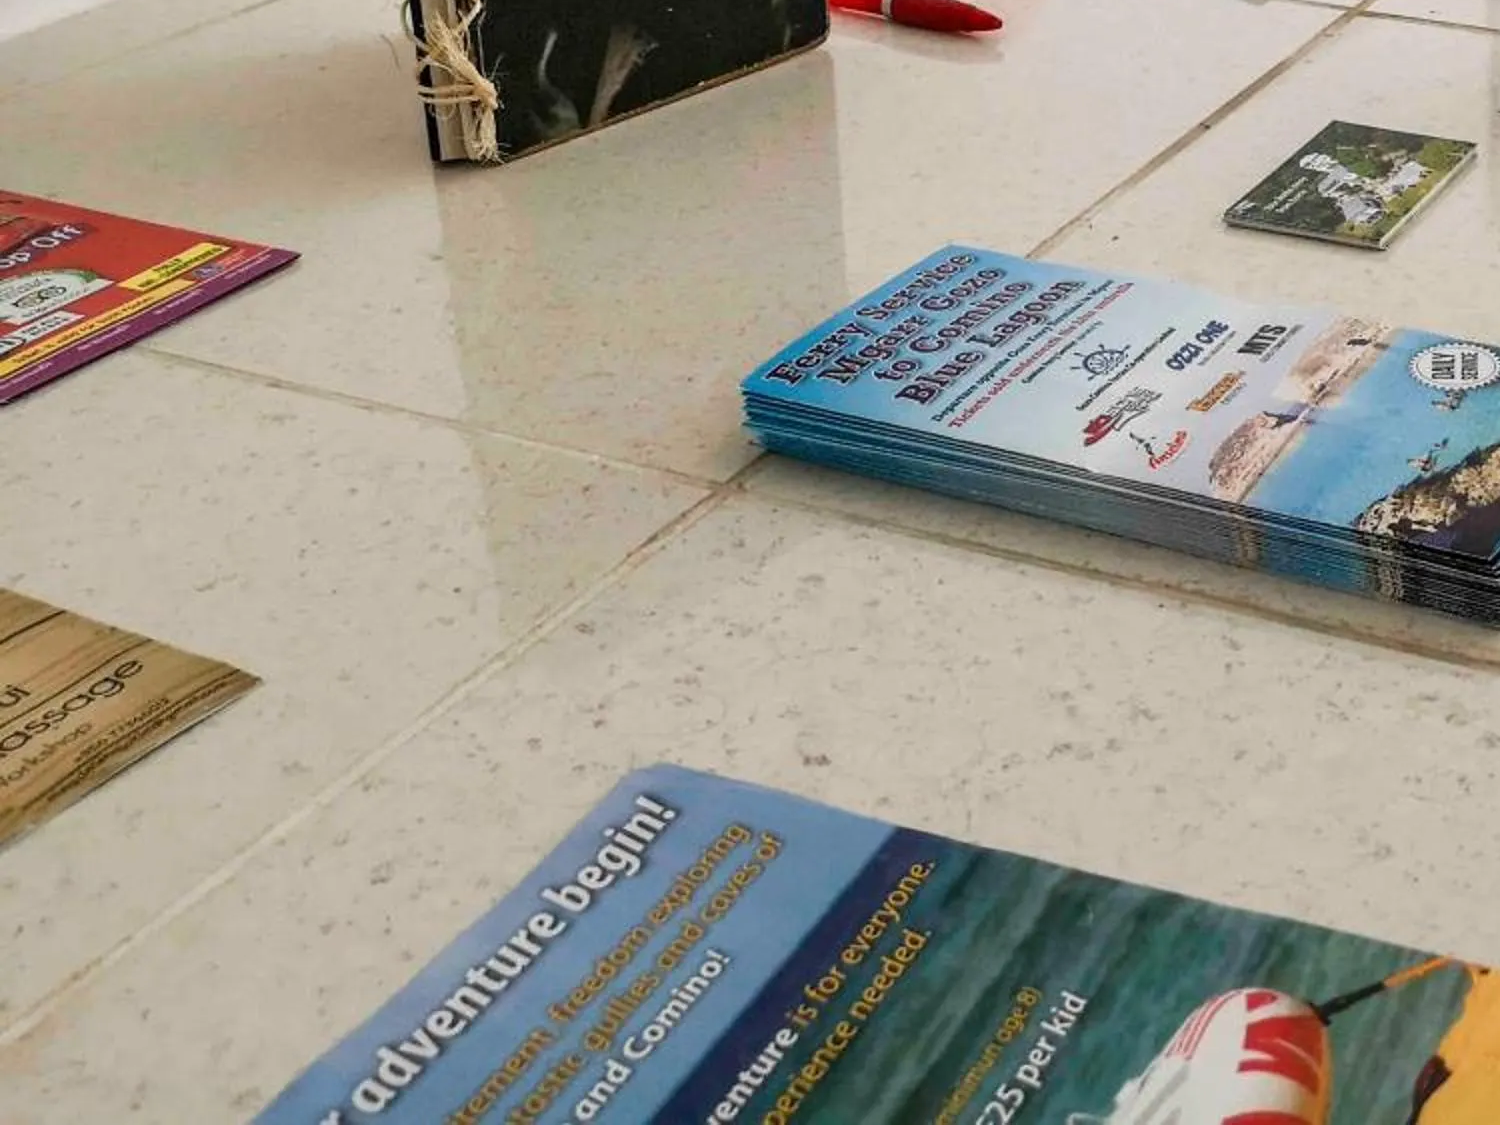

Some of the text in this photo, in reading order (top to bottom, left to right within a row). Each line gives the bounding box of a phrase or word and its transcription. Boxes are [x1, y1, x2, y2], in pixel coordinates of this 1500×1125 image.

[0, 252, 31, 269] op
[766, 251, 978, 386] Ferry Service
[816, 267, 1007, 386] Mgarr Gozo
[872, 281, 1034, 382] to Comino
[895, 279, 1087, 406] Blue Lagoon
[1166, 341, 1204, 370] OZZI
[1195, 320, 1229, 345] ONE
[1237, 324, 1287, 355] MTS
[1431, 352, 1455, 380] DAILY
[1461, 352, 1478, 380] SERVICE
[931, 385, 977, 421] Departure
[948, 397, 991, 427] Tickets
[988, 379, 1012, 395] sold
[0, 659, 143, 758] assage
[351, 795, 679, 1113] adventure begin!
[548, 925, 649, 1022] freedom
[649, 823, 752, 923] exploring
[584, 971, 662, 1053] gullies
[657, 922, 703, 971] and
[702, 862, 763, 921] caves
[758, 832, 784, 861] of
[575, 948, 731, 1121] and Comino!
[706, 861, 936, 1125] venture is for everyone.
[763, 928, 933, 1125] perience needed.
[995, 1005, 1028, 1043] age
[1015, 985, 1043, 1008] 8)
[1016, 1035, 1057, 1089] per
[1040, 990, 1088, 1037] kid
